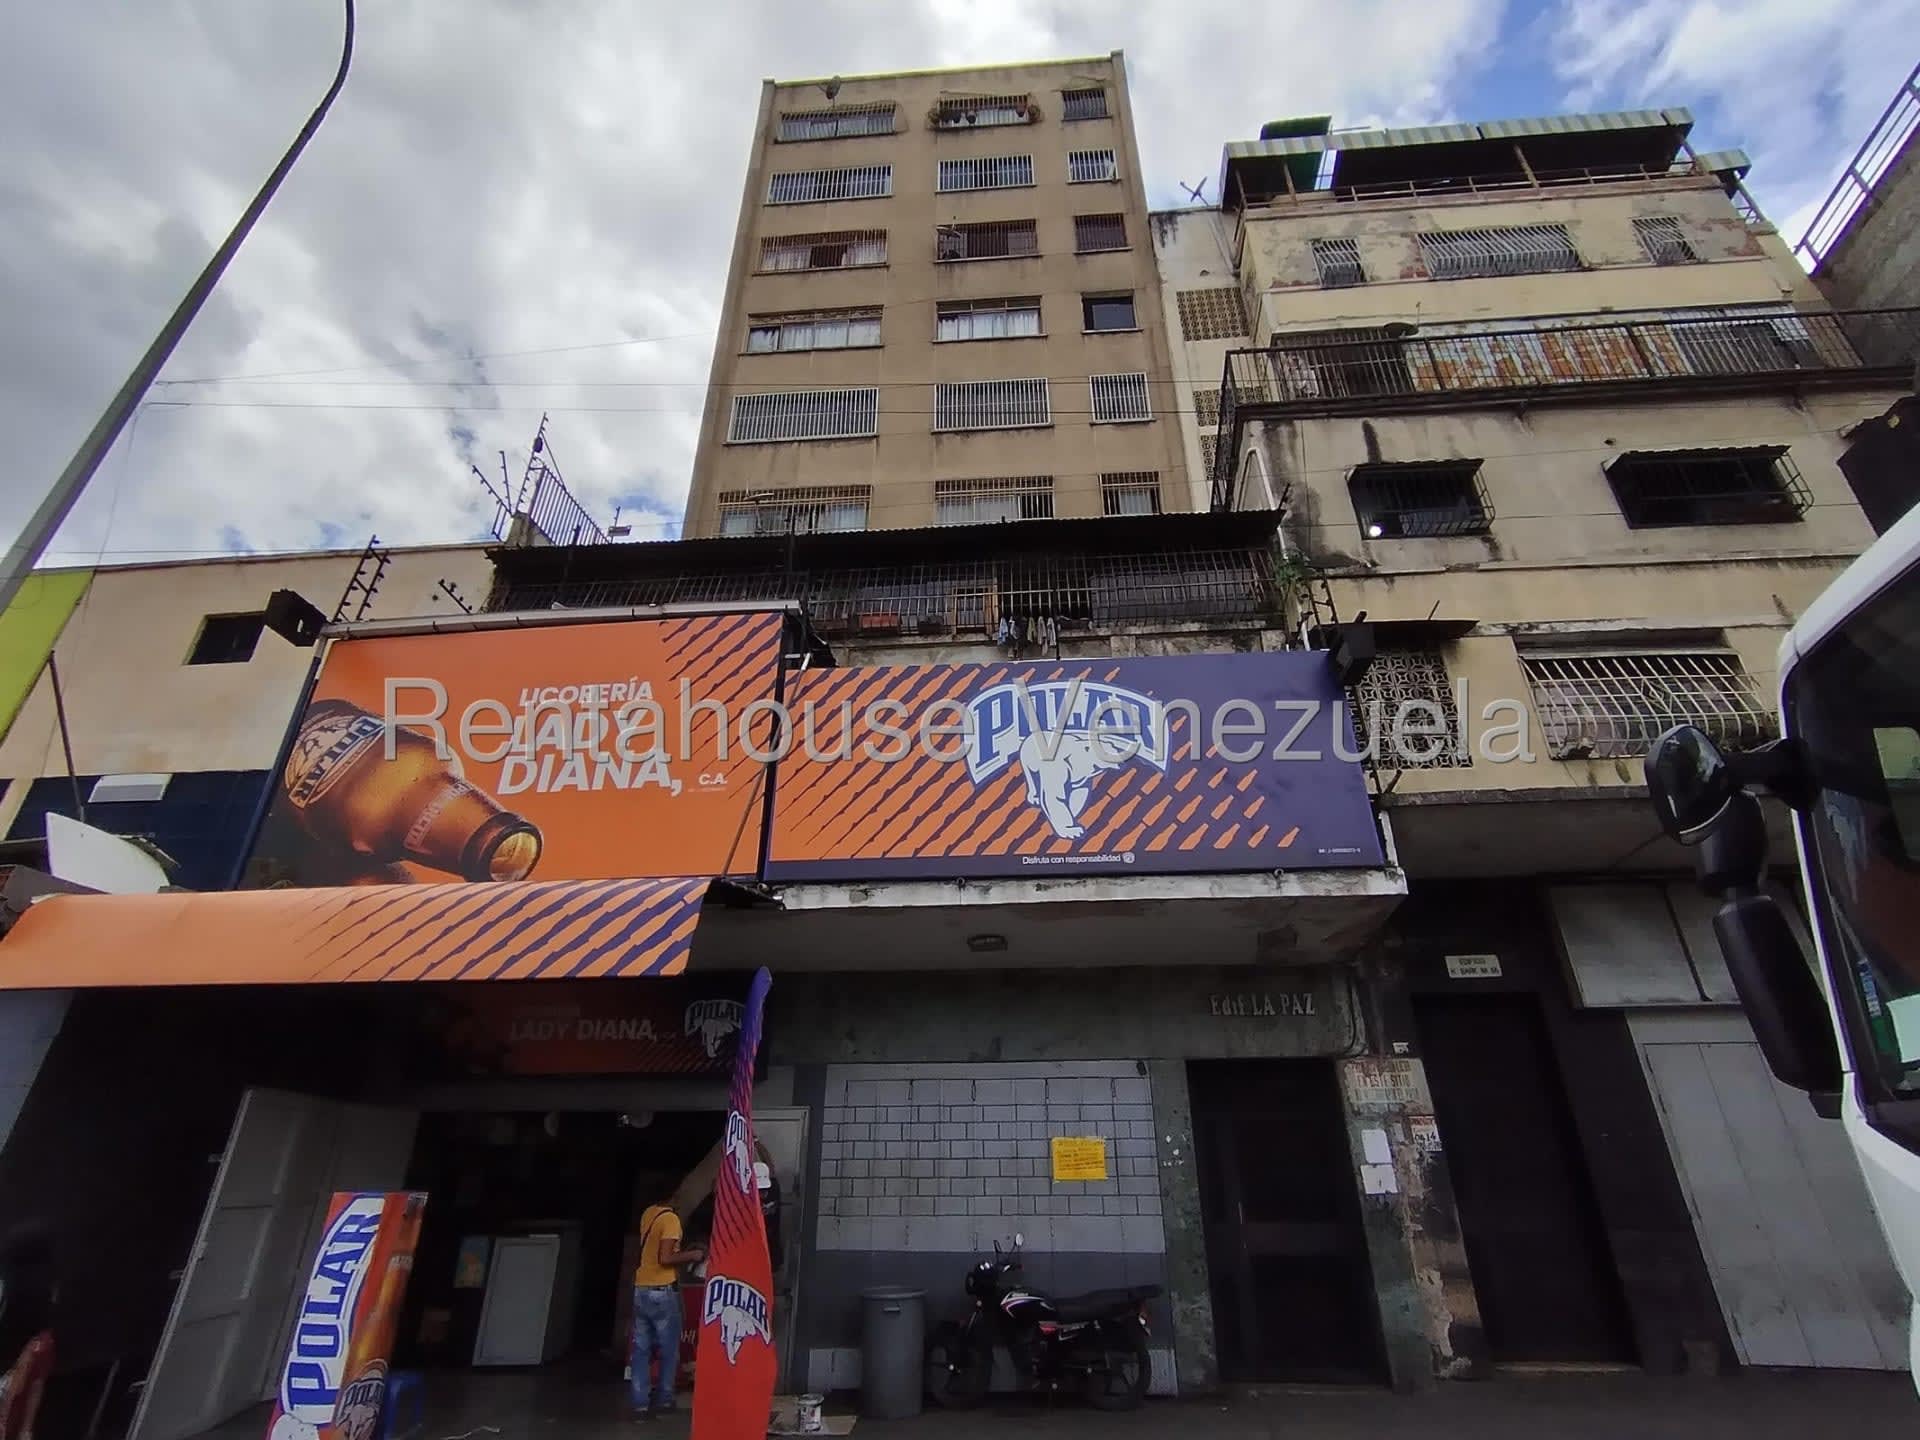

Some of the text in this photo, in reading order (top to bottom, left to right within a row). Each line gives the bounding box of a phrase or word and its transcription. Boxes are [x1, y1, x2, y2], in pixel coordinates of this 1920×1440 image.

[510, 708, 650, 753] LADY
[975, 688, 1156, 768] POLAR
[1022, 854, 1121, 865] Disfruta con responsabilidad
[1251, 993, 1276, 1016] LA
[1279, 992, 1316, 1015] PAZ
[511, 1020, 570, 1041] LADY
[287, 1214, 384, 1411] POLAR
